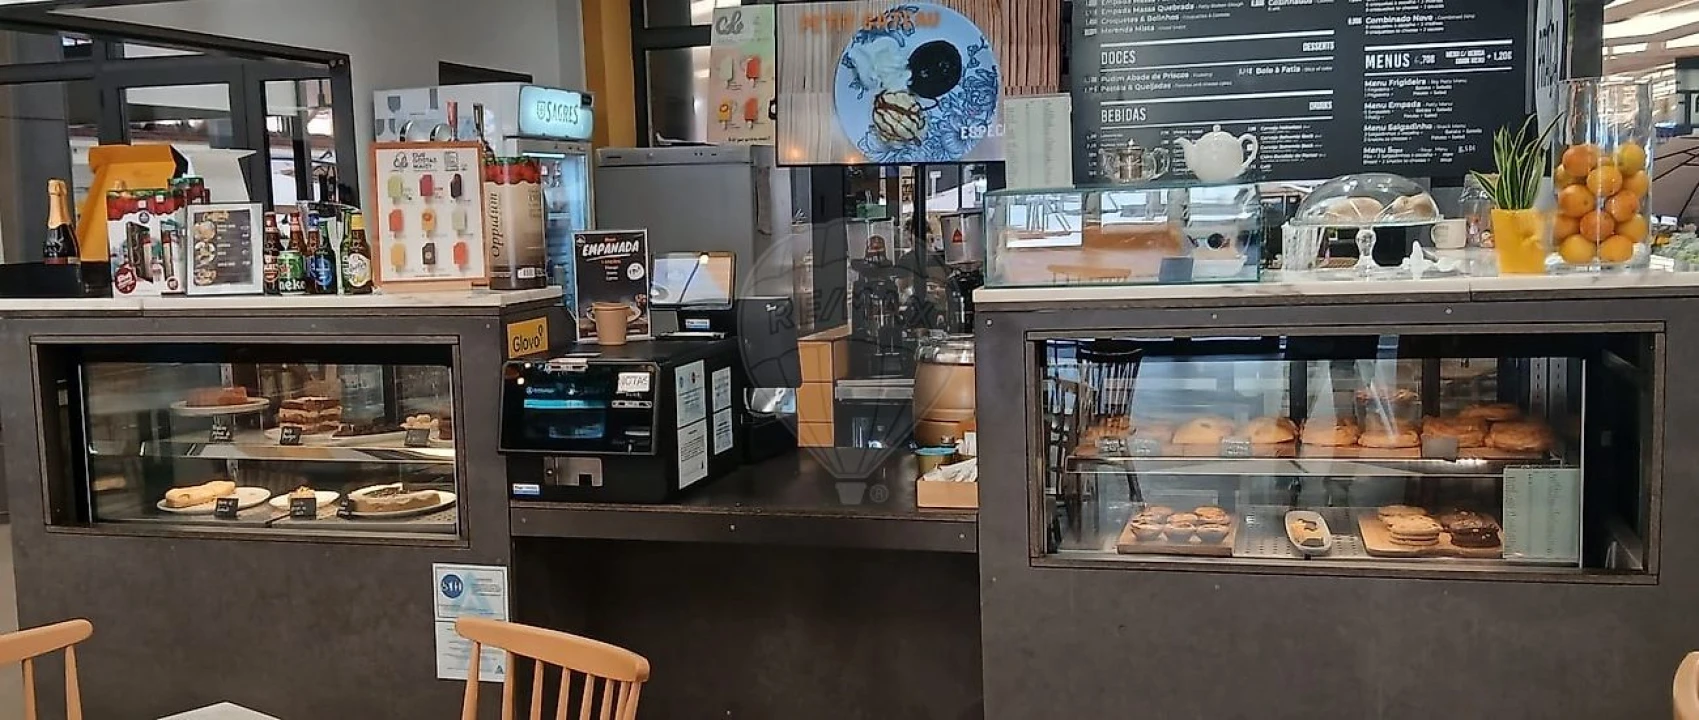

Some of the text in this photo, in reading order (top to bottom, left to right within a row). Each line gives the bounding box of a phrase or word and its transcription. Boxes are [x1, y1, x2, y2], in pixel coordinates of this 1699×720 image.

[1157, 3, 1194, 13] Quebrada
[1365, 15, 1411, 24] Combinado
[1101, 50, 1136, 65] DOCES
[1365, 53, 1410, 69] MENUS
[1135, 83, 1172, 92] Queijadas
[1364, 79, 1387, 87] Menu
[1388, 77, 1427, 88] Frigideira
[1388, 101, 1421, 110] Empada
[545, 101, 579, 125] SAGRES
[1101, 108, 1146, 123] BEBIDAS
[1363, 124, 1387, 132] Menu
[1388, 122, 1433, 132] Salgadinho
[582, 239, 640, 257] EMPANADA
[513, 332, 542, 353] Glovo
